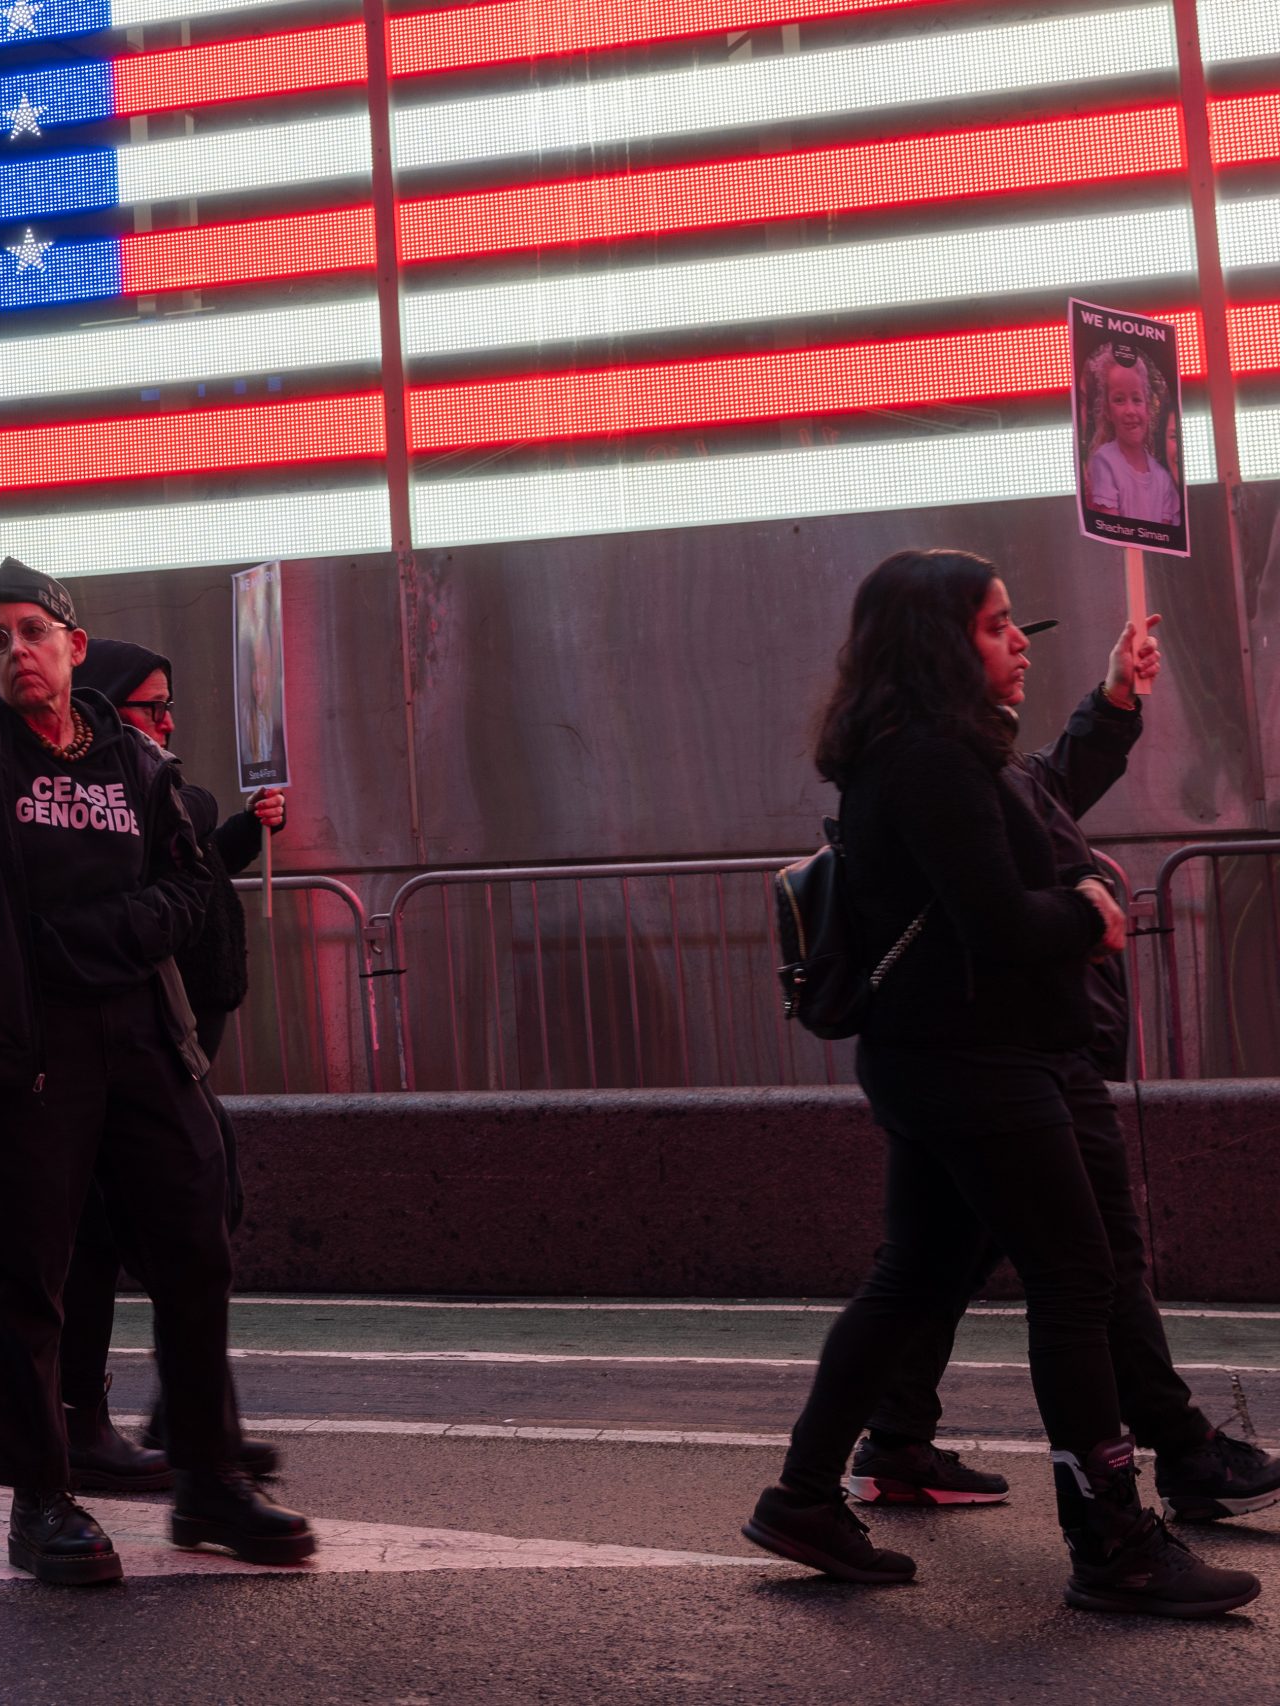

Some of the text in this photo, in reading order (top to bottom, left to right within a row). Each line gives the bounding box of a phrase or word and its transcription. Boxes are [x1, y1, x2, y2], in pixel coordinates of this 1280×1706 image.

[1081, 310, 1166, 342] WE MOURN
[1095, 519, 1170, 542] Shachar Siman
[32, 776, 127, 808] CEASE
[16, 796, 140, 836] GENOCIDE
